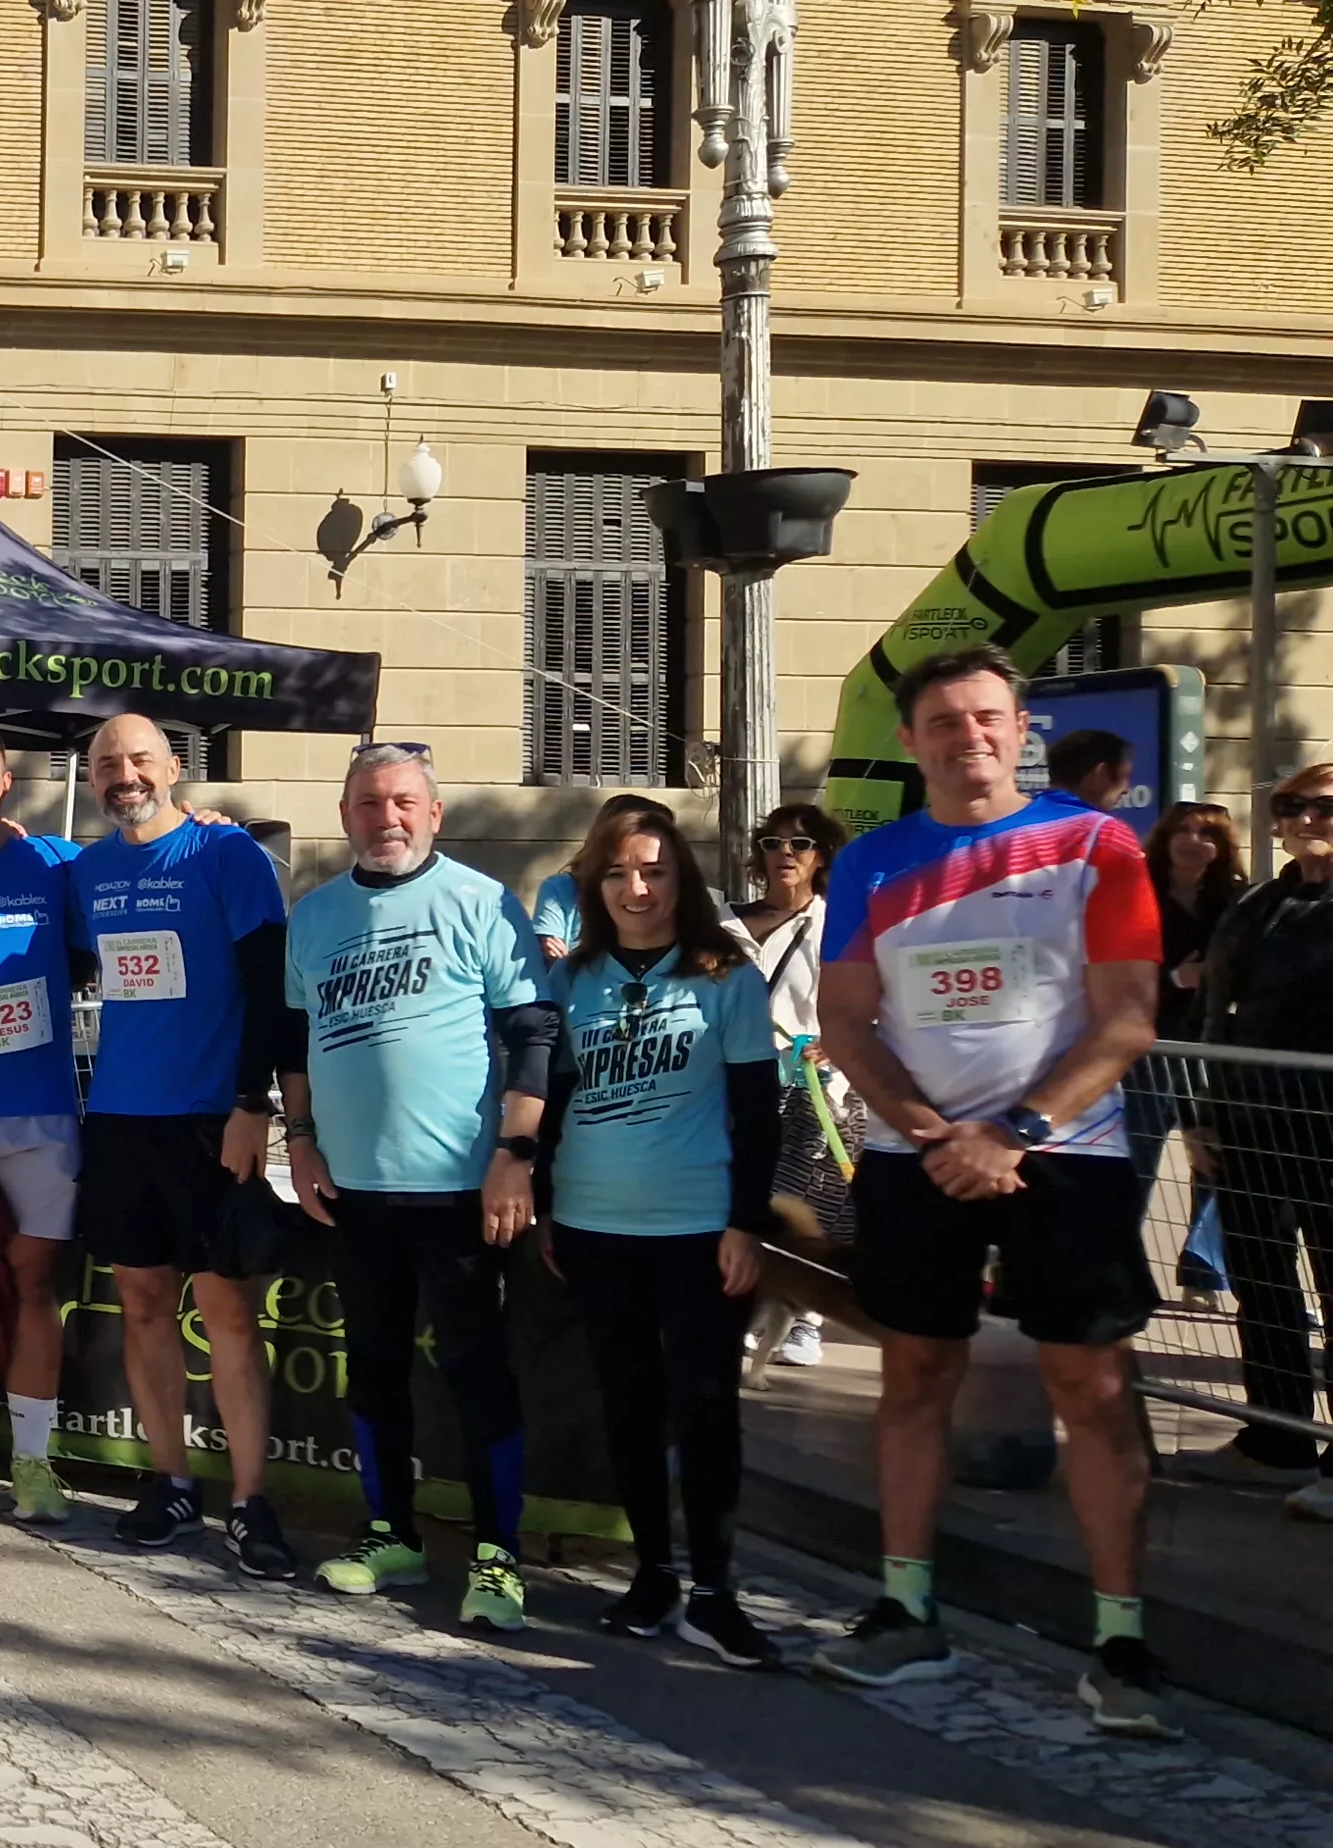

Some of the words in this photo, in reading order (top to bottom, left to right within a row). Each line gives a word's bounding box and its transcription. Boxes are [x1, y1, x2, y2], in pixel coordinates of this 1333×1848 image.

[148, 876, 185, 890] kablex
[7, 892, 48, 908] kablex
[93, 895, 129, 913] NEXT
[117, 954, 161, 976] 532
[330, 955, 349, 976] III
[350, 944, 411, 969] CARRERA
[123, 978, 155, 988] DAVID
[317, 957, 432, 1019] EMPRESAS
[930, 966, 1004, 995] 398
[946, 995, 991, 1008] JOSE
[329, 1011, 350, 1028] ESIC
[351, 1001, 397, 1021] HUESCA
[582, 1028, 600, 1049] III
[577, 1030, 694, 1091] MPRESAS
[585, 1090, 608, 1105] ESIC
[611, 1079, 656, 1100] HUESCA
